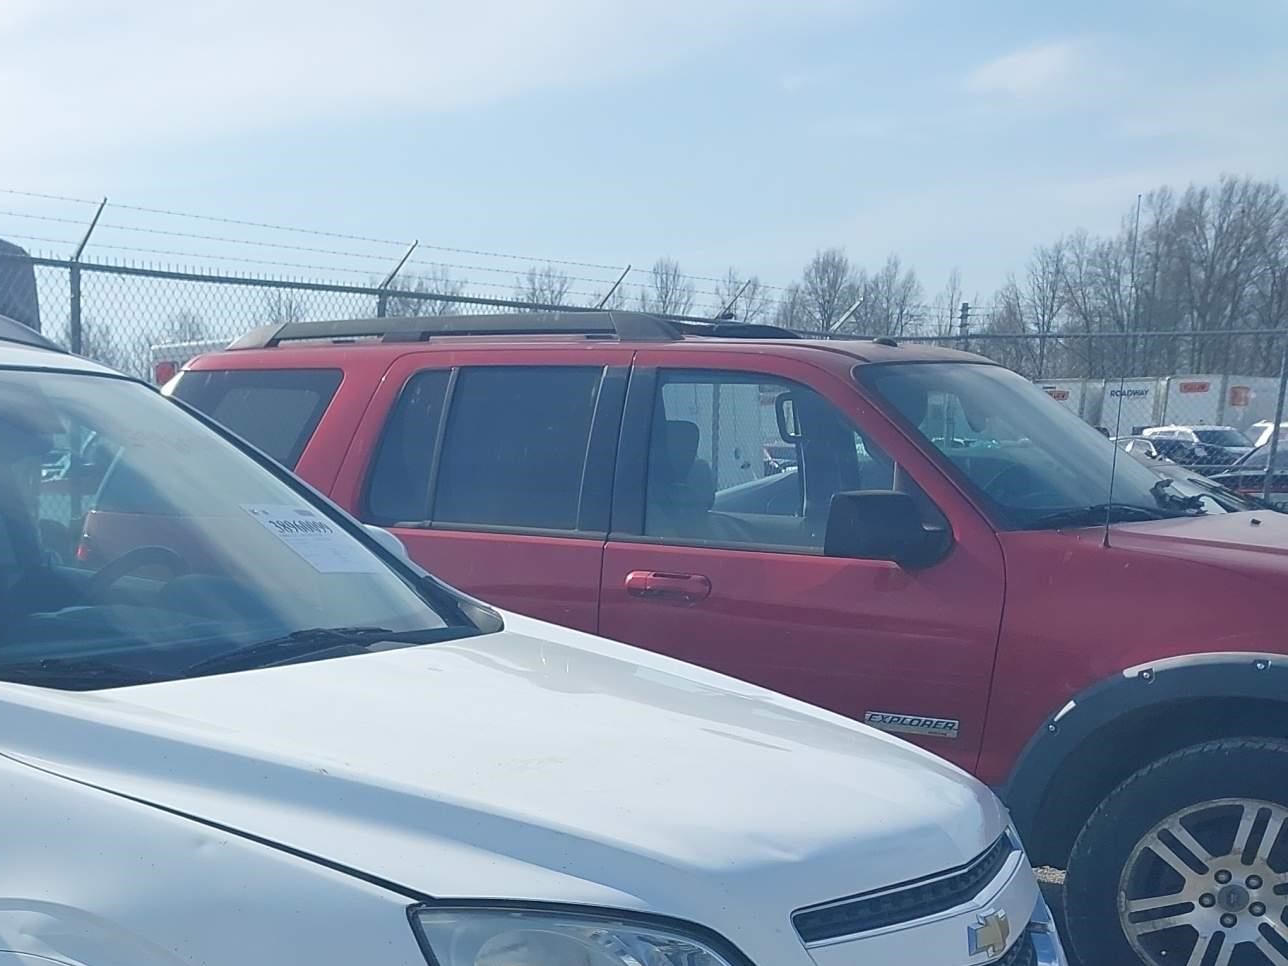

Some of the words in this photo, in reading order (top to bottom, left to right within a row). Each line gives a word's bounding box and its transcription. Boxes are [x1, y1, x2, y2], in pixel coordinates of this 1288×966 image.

[1110, 389, 1149, 398] ROADWAY
[268, 520, 334, 534] 38960099
[868, 713, 959, 731] EXPLORER
